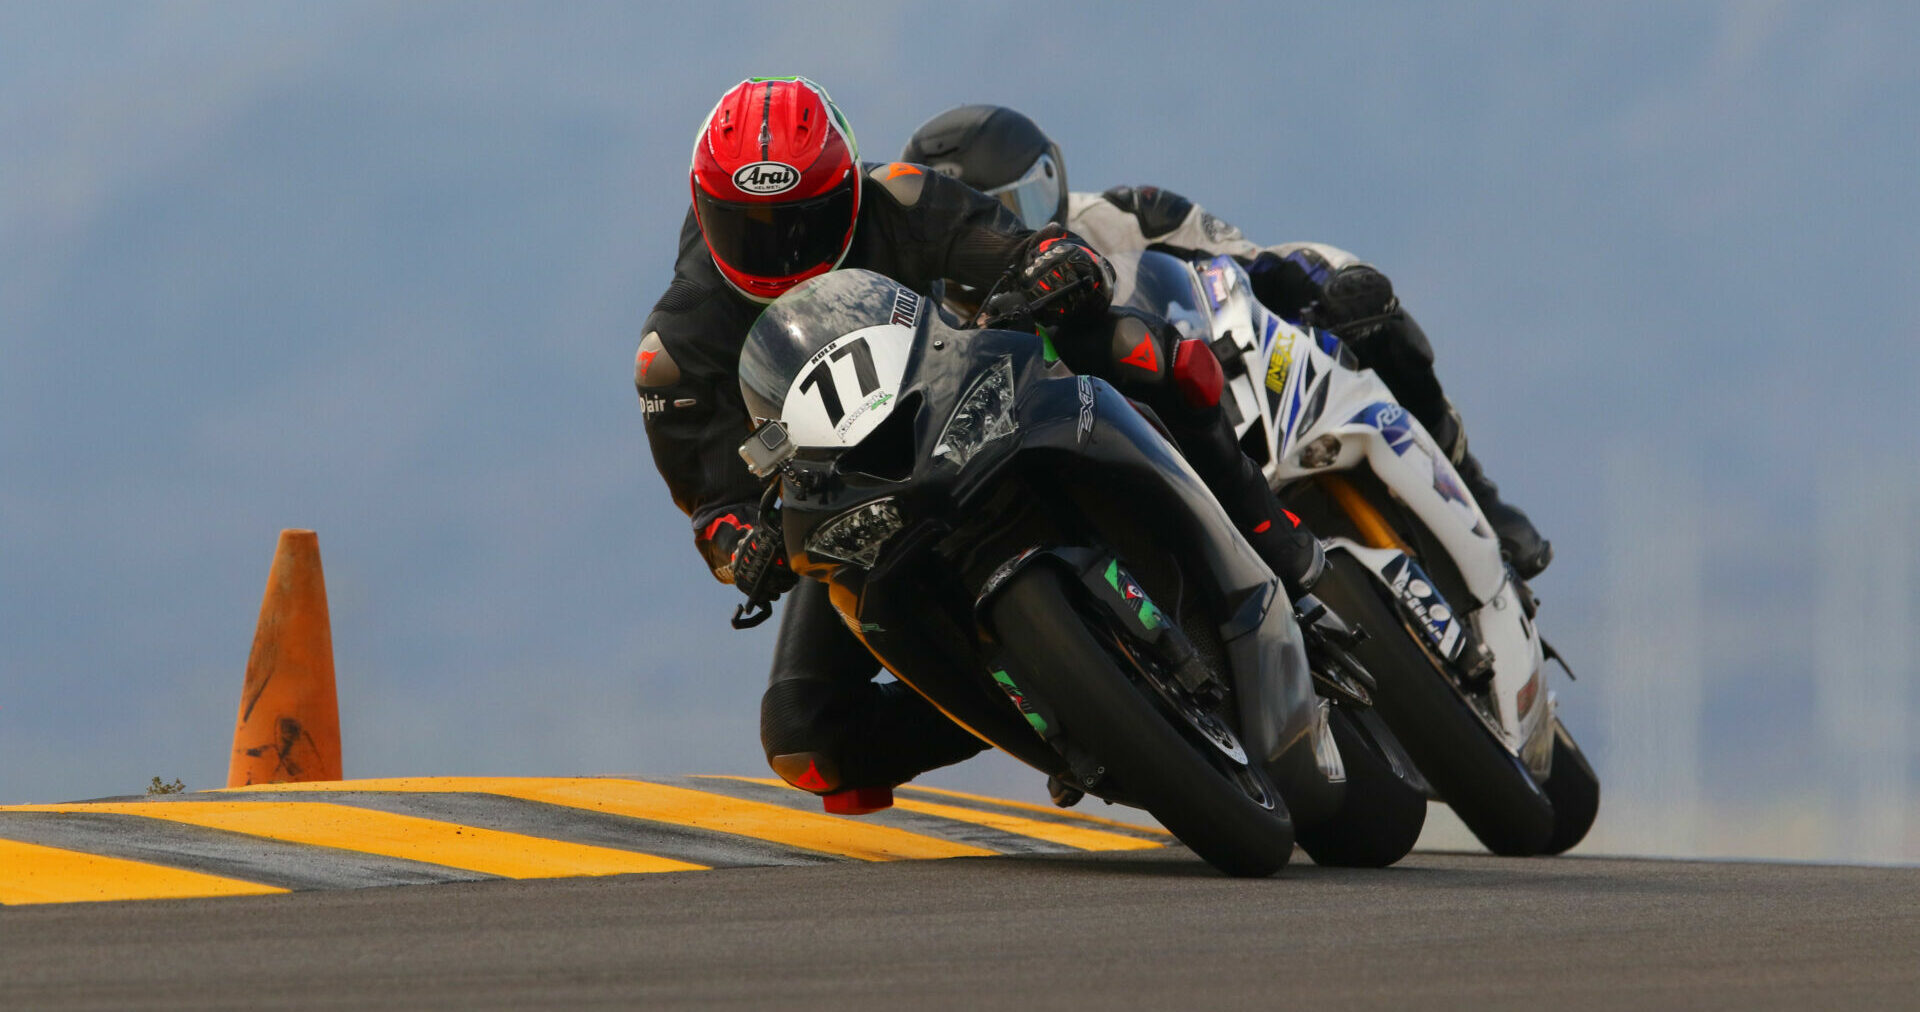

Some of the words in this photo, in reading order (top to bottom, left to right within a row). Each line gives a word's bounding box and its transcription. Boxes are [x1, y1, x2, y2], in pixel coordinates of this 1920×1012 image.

[738, 166, 790, 185] Arai
[811, 342, 838, 366] KOLB
[799, 337, 881, 429] 77
